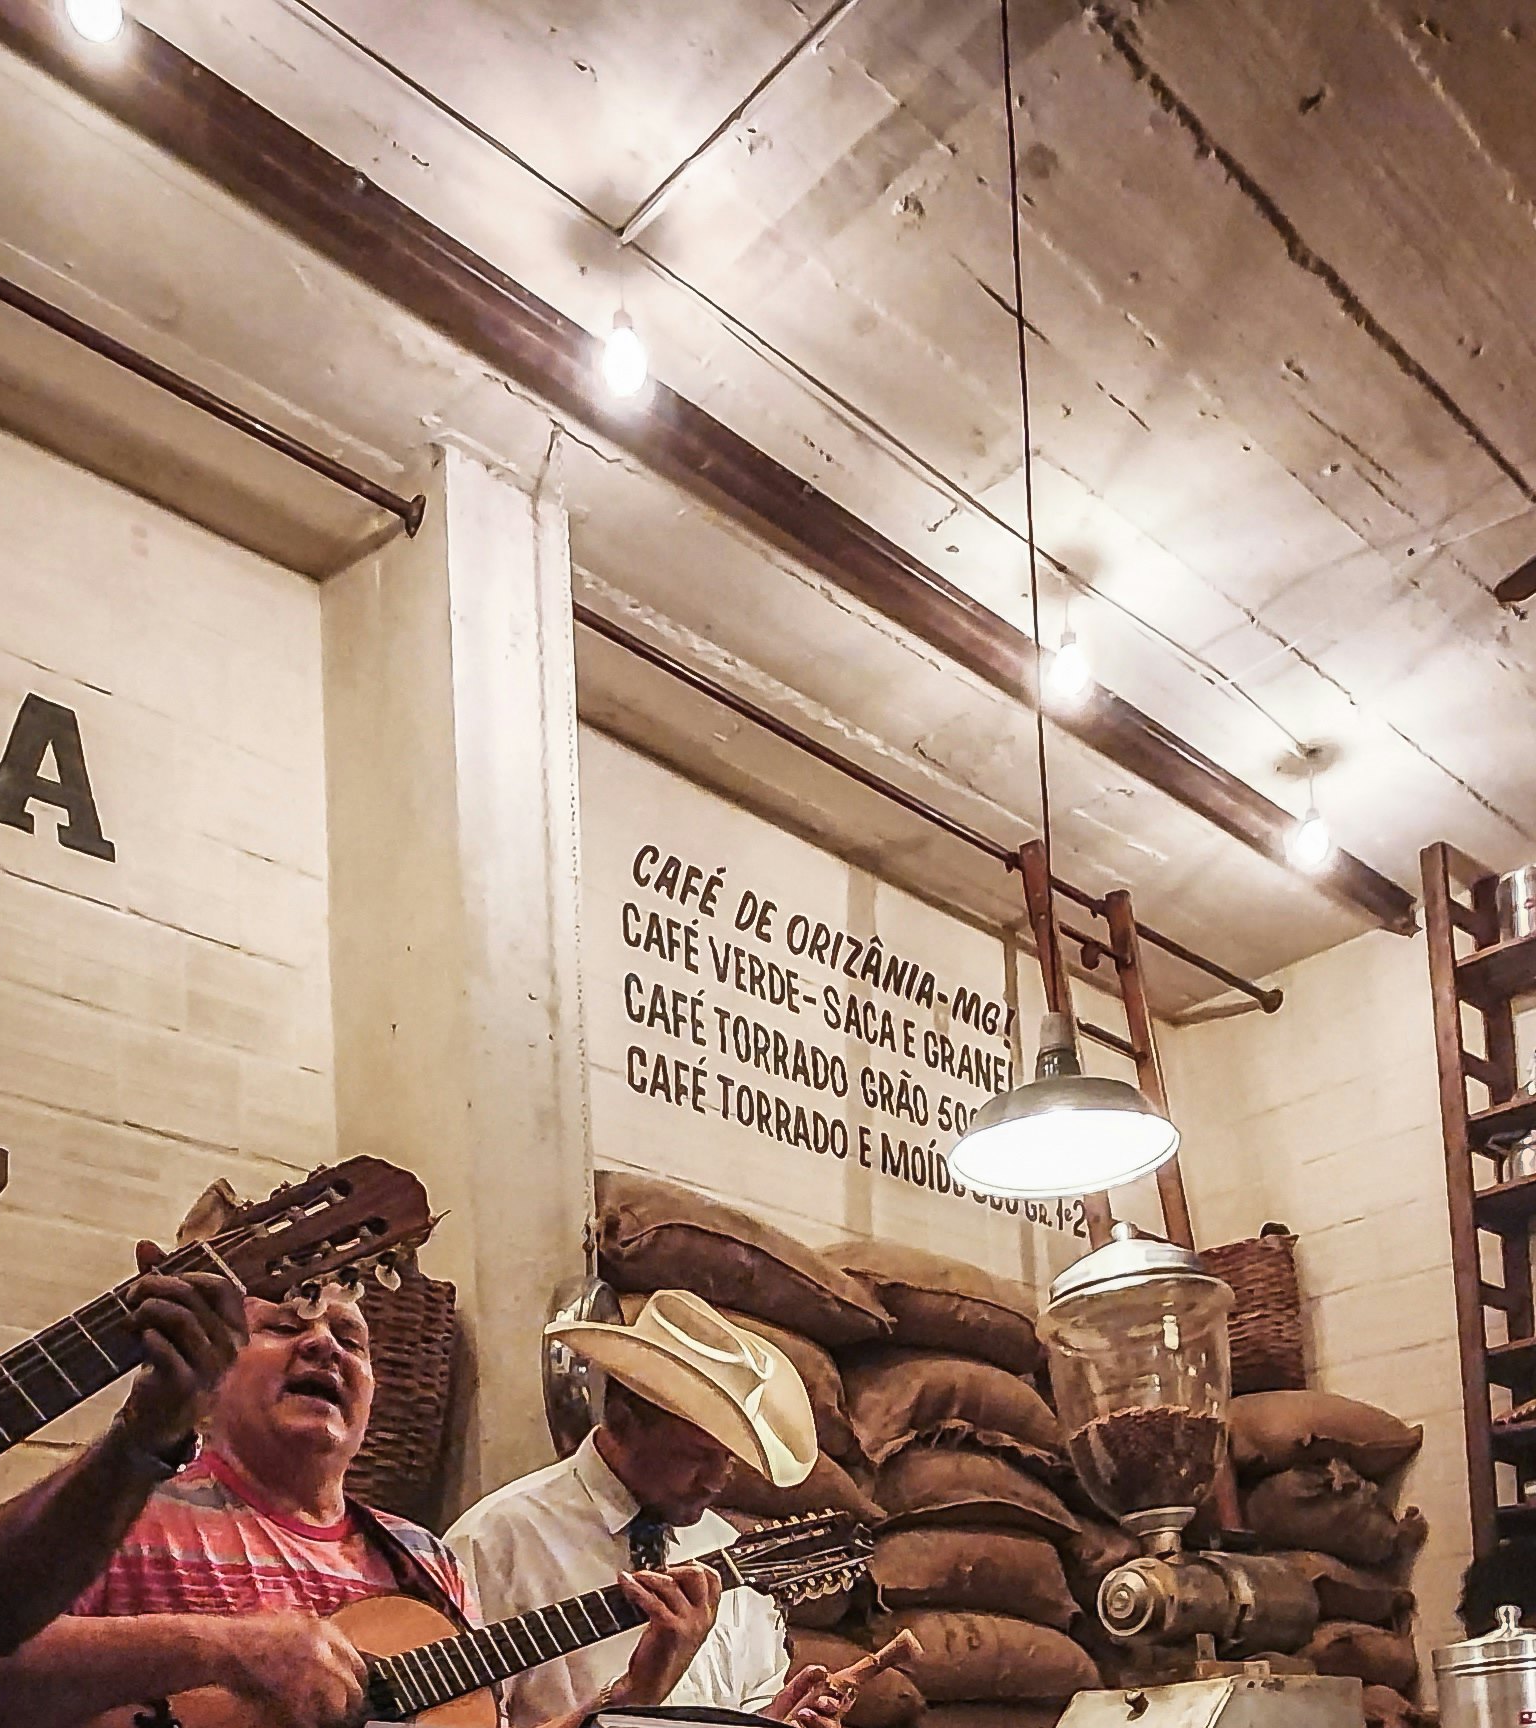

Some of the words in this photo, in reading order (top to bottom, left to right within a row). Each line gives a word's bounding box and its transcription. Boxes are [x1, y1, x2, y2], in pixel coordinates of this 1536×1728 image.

[632, 844, 727, 918] CAFÉ
[734, 889, 778, 944] DE
[622, 902, 700, 975] CAFÉ
[903, 1018, 916, 1060] E
[624, 972, 707, 1047] CAFÉ
[713, 1006, 849, 1098] TORRADO
[860, 1066, 929, 1127] GRÃO
[937, 1095, 978, 1137] 50
[627, 1045, 708, 1115] CAFÉ
[716, 1073, 849, 1160] TORRADO
[858, 1125, 872, 1169] E
